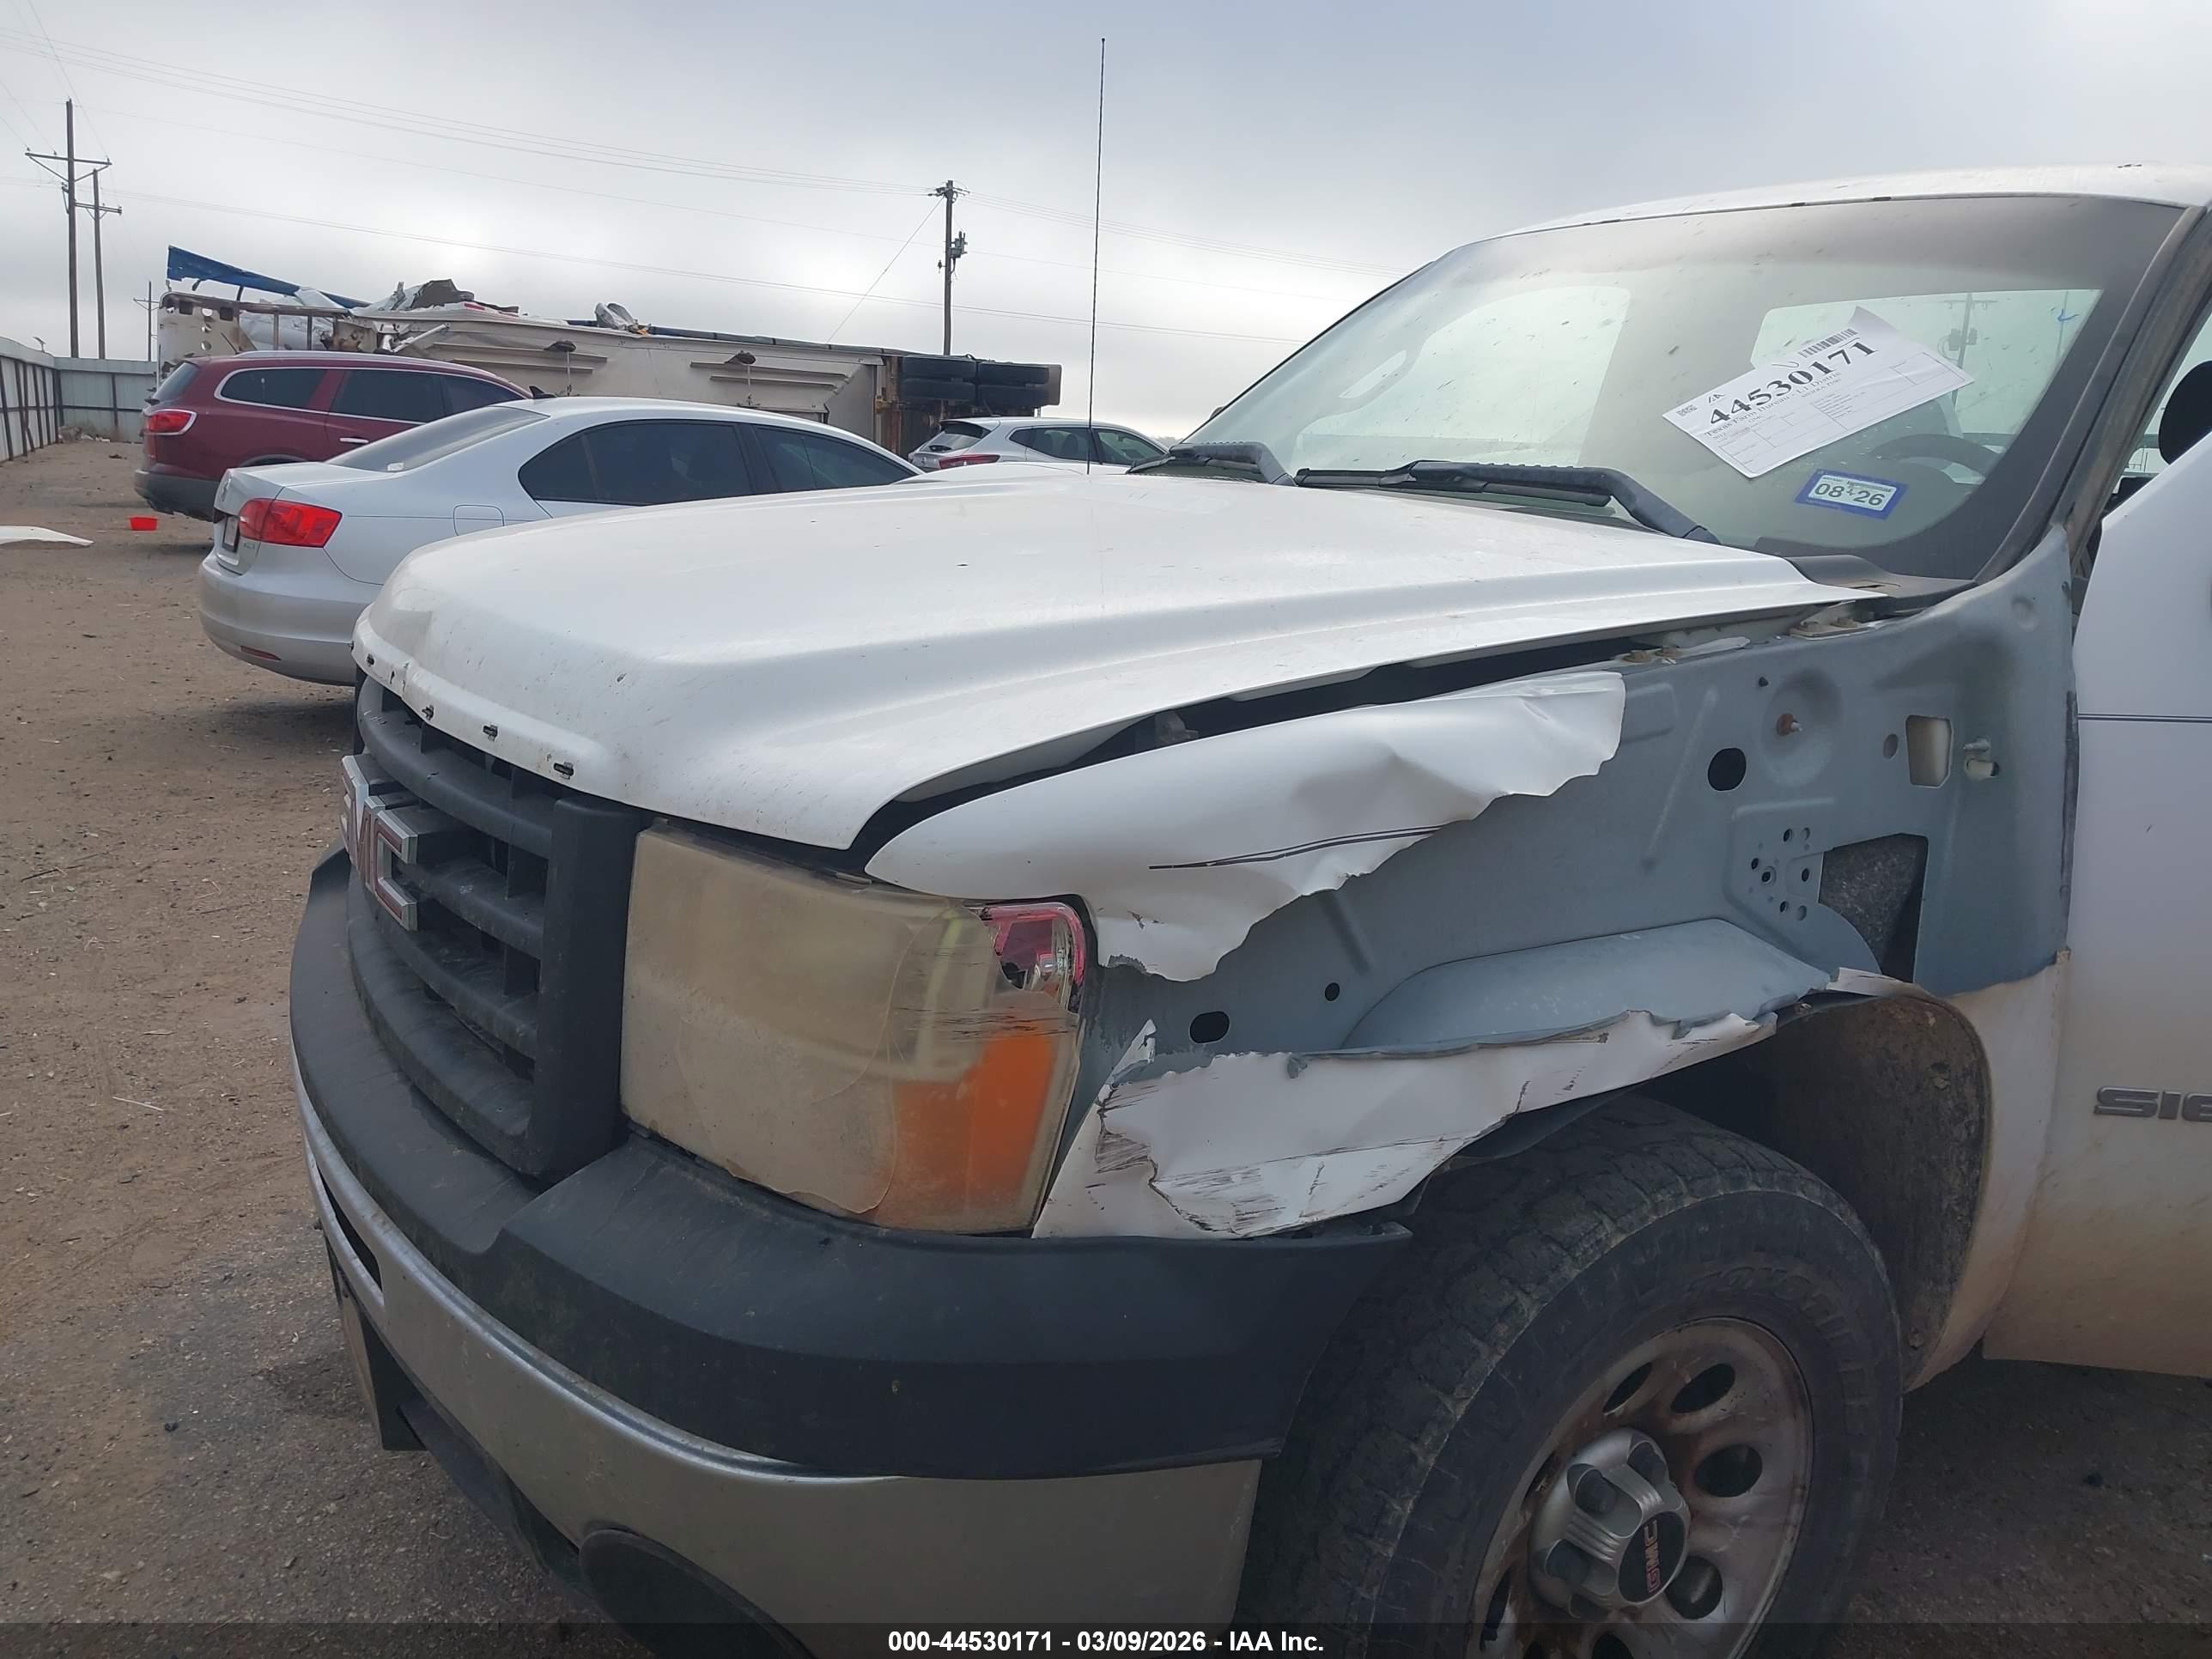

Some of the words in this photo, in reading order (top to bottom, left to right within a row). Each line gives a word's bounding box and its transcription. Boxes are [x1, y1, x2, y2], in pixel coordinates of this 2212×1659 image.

[1711, 342, 1878, 424] 44530171
[1705, 422, 1733, 437] Texas
[1735, 410, 1757, 424] Farm
[1759, 395, 1790, 413] Bureau
[1814, 483, 1844, 498] 08
[1853, 489, 1885, 506] 26
[1644, 1518, 1662, 1595] GMC
